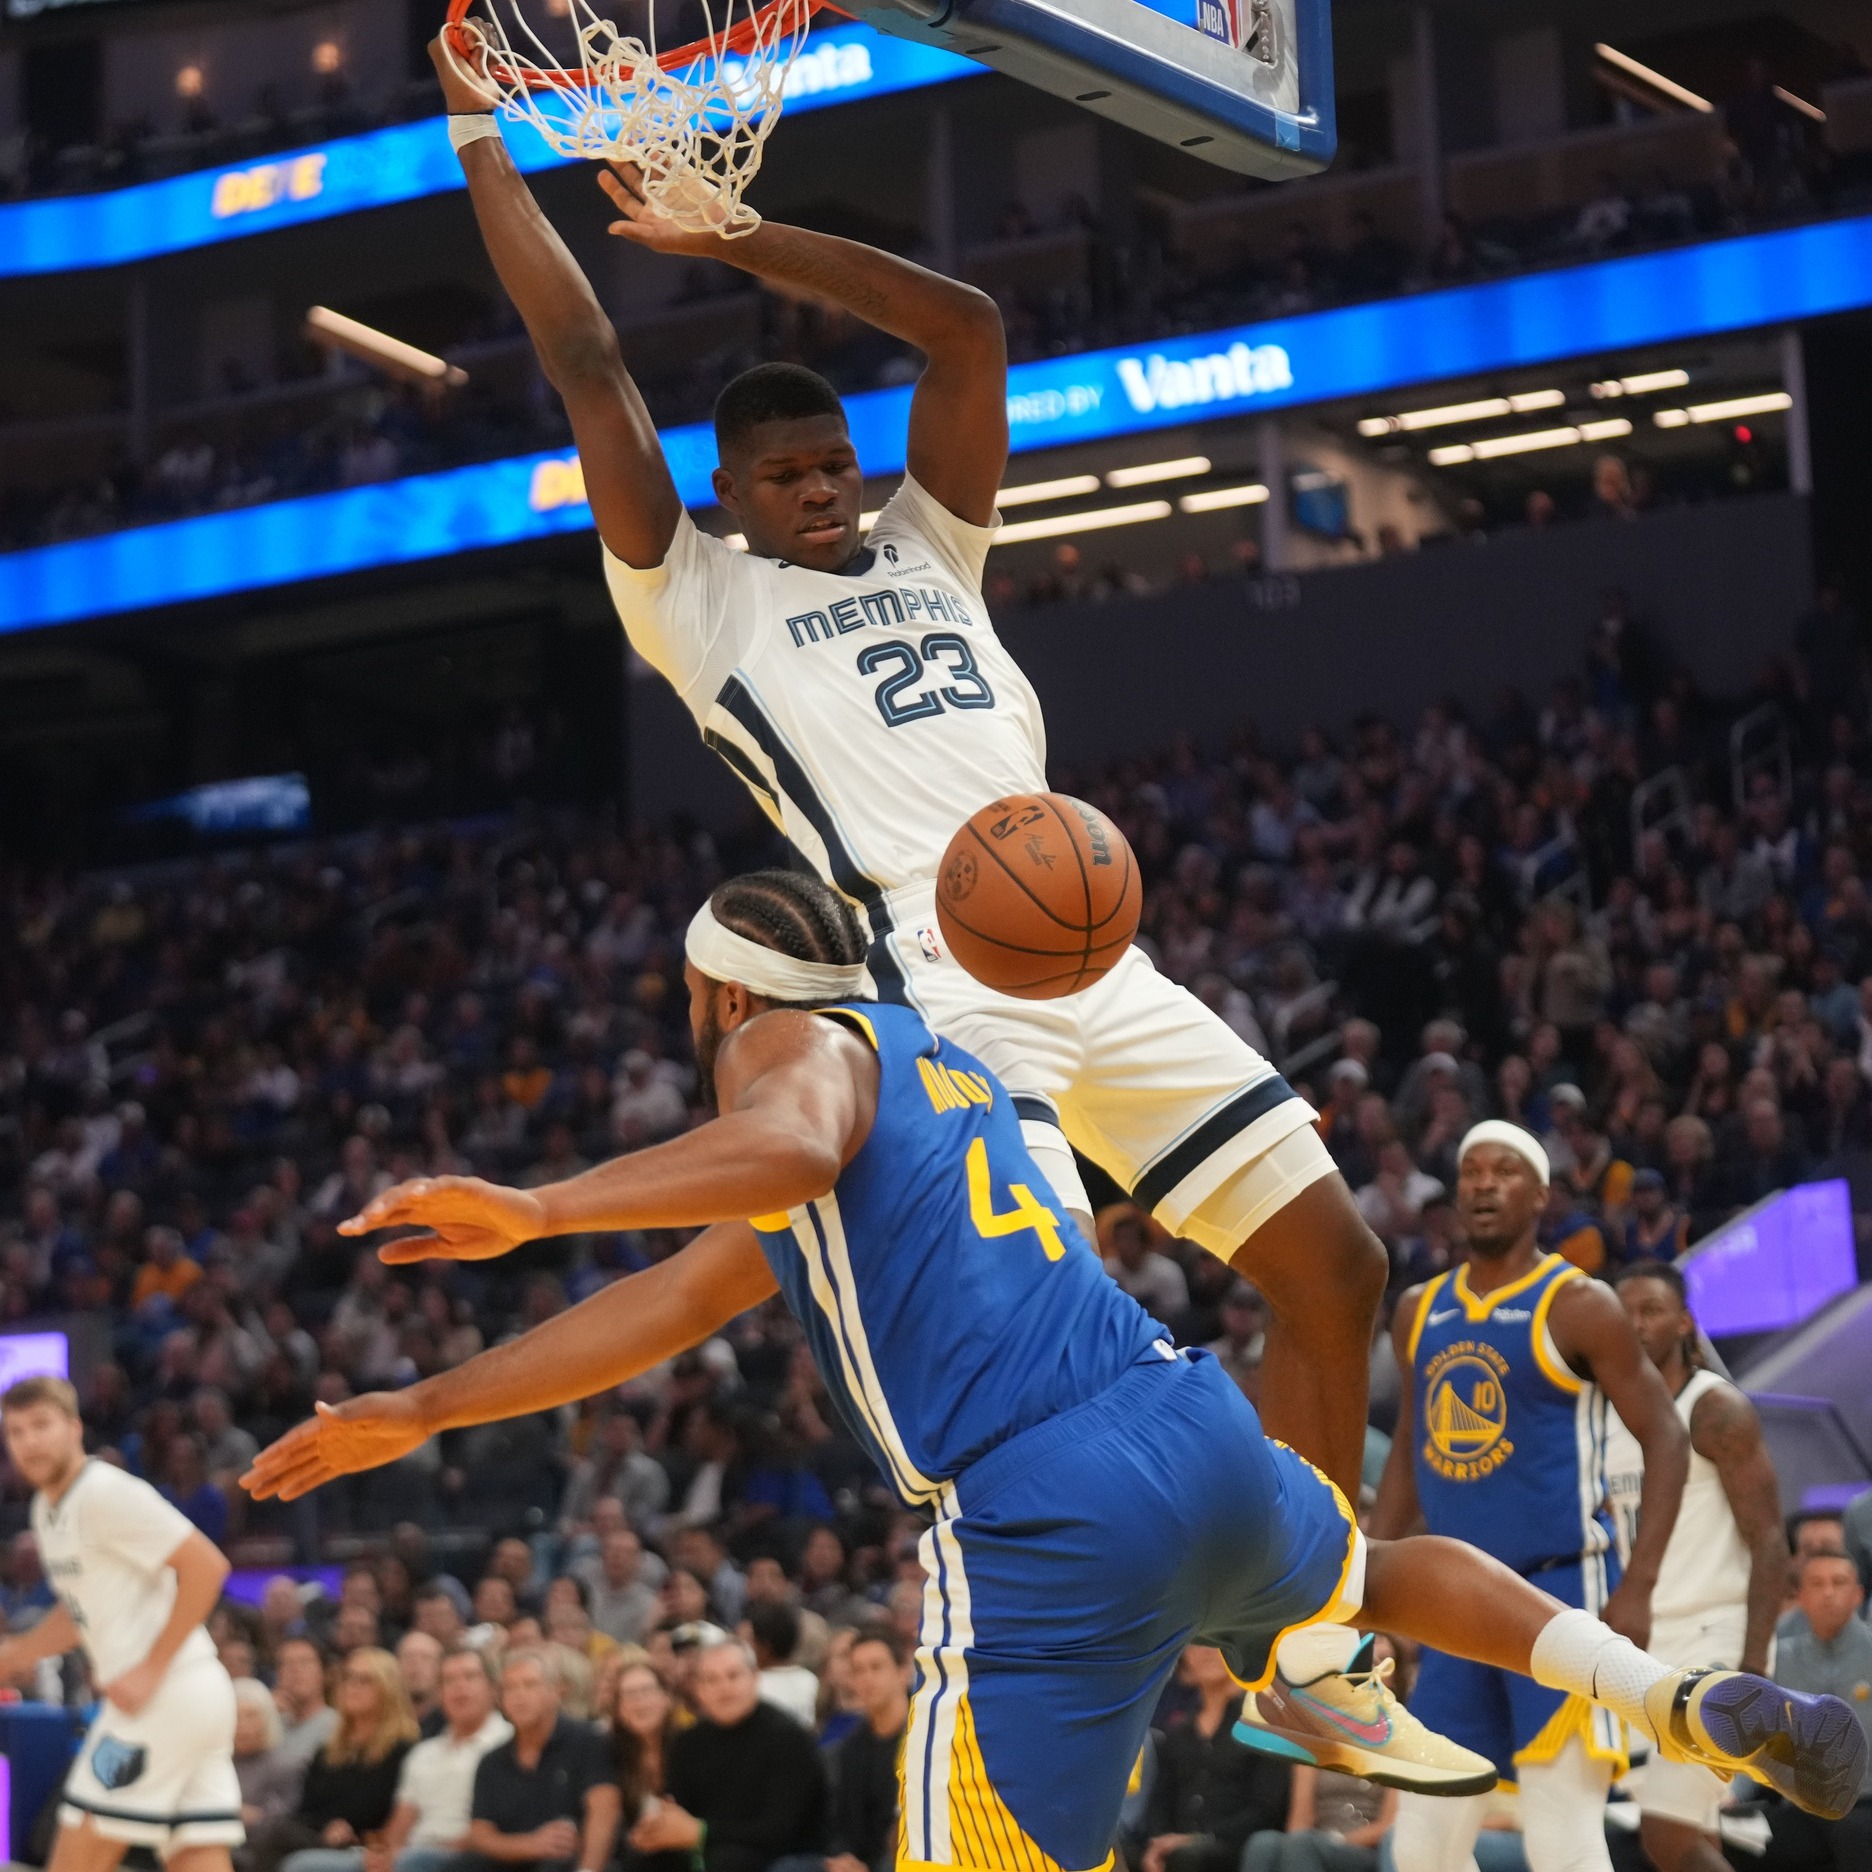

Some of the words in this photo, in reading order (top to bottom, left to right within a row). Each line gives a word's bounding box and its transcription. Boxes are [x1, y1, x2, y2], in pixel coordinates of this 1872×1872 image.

[1202, 1, 1225, 37] NBA
[721, 42, 873, 108] Vanta
[1115, 341, 1294, 413] Vanta
[887, 561, 931, 578] Robinhood
[785, 587, 973, 648] MEMPHIS
[856, 632, 996, 728] 23
[965, 1136, 1067, 1262] 4
[1425, 1340, 1476, 1377] GOLDEN
[1477, 1341, 1511, 1376] STATE
[1473, 1379, 1498, 1414] 10
[1424, 1436, 1515, 1481] WARRIORS
